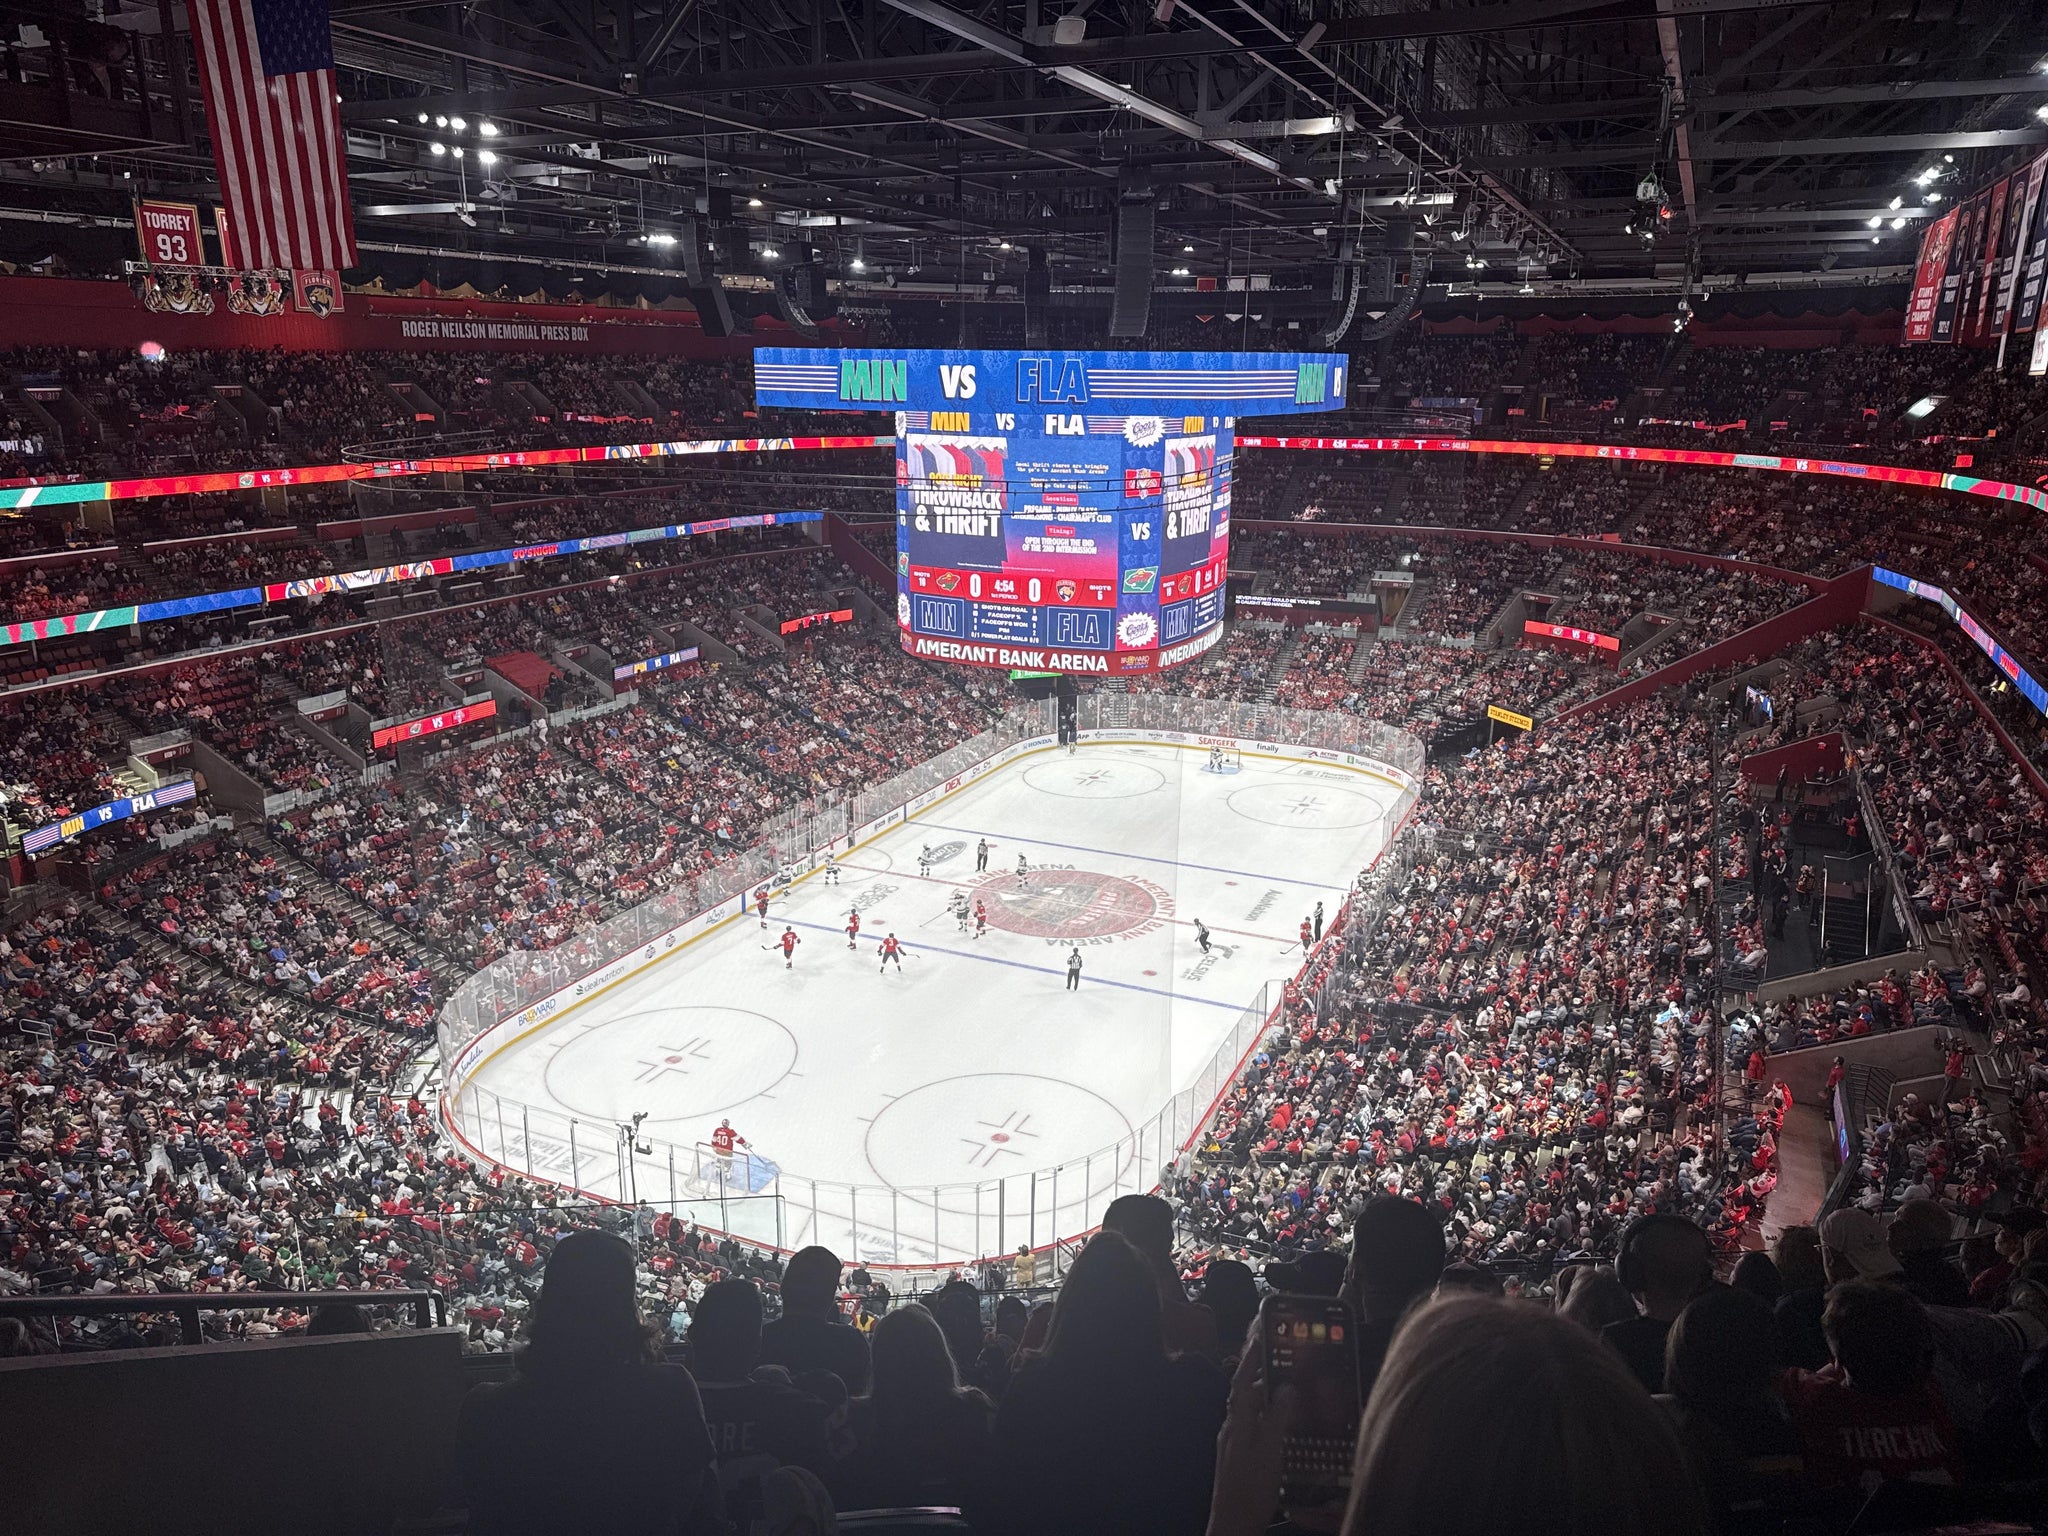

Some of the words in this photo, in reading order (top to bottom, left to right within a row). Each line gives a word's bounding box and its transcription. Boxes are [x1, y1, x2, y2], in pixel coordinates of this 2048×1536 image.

[143, 211, 190, 231] TORREY
[156, 233, 188, 262] 93
[402, 320, 440, 338] ROGER
[441, 322, 486, 339] NEILSON
[487, 323, 540, 340] MEMORIAL
[541, 325, 570, 341] PRESS
[571, 326, 590, 341] BOX
[840, 359, 907, 402] MIN
[939, 364, 977, 399] VS
[1016, 358, 1088, 404] FLA
[930, 411, 970, 432] MIN
[995, 413, 1015, 431] VS
[1045, 414, 1086, 436] FLA
[1796, 460, 1808, 471] VS
[914, 483, 1003, 510] THROWBACK
[915, 504, 931, 532] &
[933, 505, 1001, 538] THRIFT
[676, 525, 686, 536] VS
[1131, 523, 1151, 541] VS
[969, 573, 982, 598] 0
[994, 579, 1015, 593] 4:54
[1028, 577, 1041, 602] 0
[921, 600, 957, 632] MIN
[988, 612, 1016, 620] FACEOFF
[1011, 606, 1028, 614] GOAL
[981, 619, 1013, 628] FACEOFFS
[1057, 612, 1100, 645] FLA
[1011, 635, 1028, 643] GOALS
[915, 637, 998, 665] AMERANT
[1000, 649, 1046, 669] BANK
[1048, 653, 1110, 673] ARENA
[1158, 638, 1203, 668] AMERANT
[432, 717, 443, 729] VS
[179, 745, 191, 755] 116
[1198, 736, 1237, 748] SEATGEEK
[1256, 742, 1280, 754] finally
[945, 775, 962, 793] DEX
[60, 815, 85, 838] MIN
[98, 806, 112, 822] VS
[131, 795, 156, 813] FLA
[967, 868, 1015, 885] BANK
[1123, 874, 1176, 918] AMERANT
[1121, 921, 1164, 940] BANK
[888, 939, 894, 947] 3
[1045, 937, 1114, 948] ARENA
[518, 998, 557, 1028] BROWARD
[714, 1134, 728, 1147] 40
